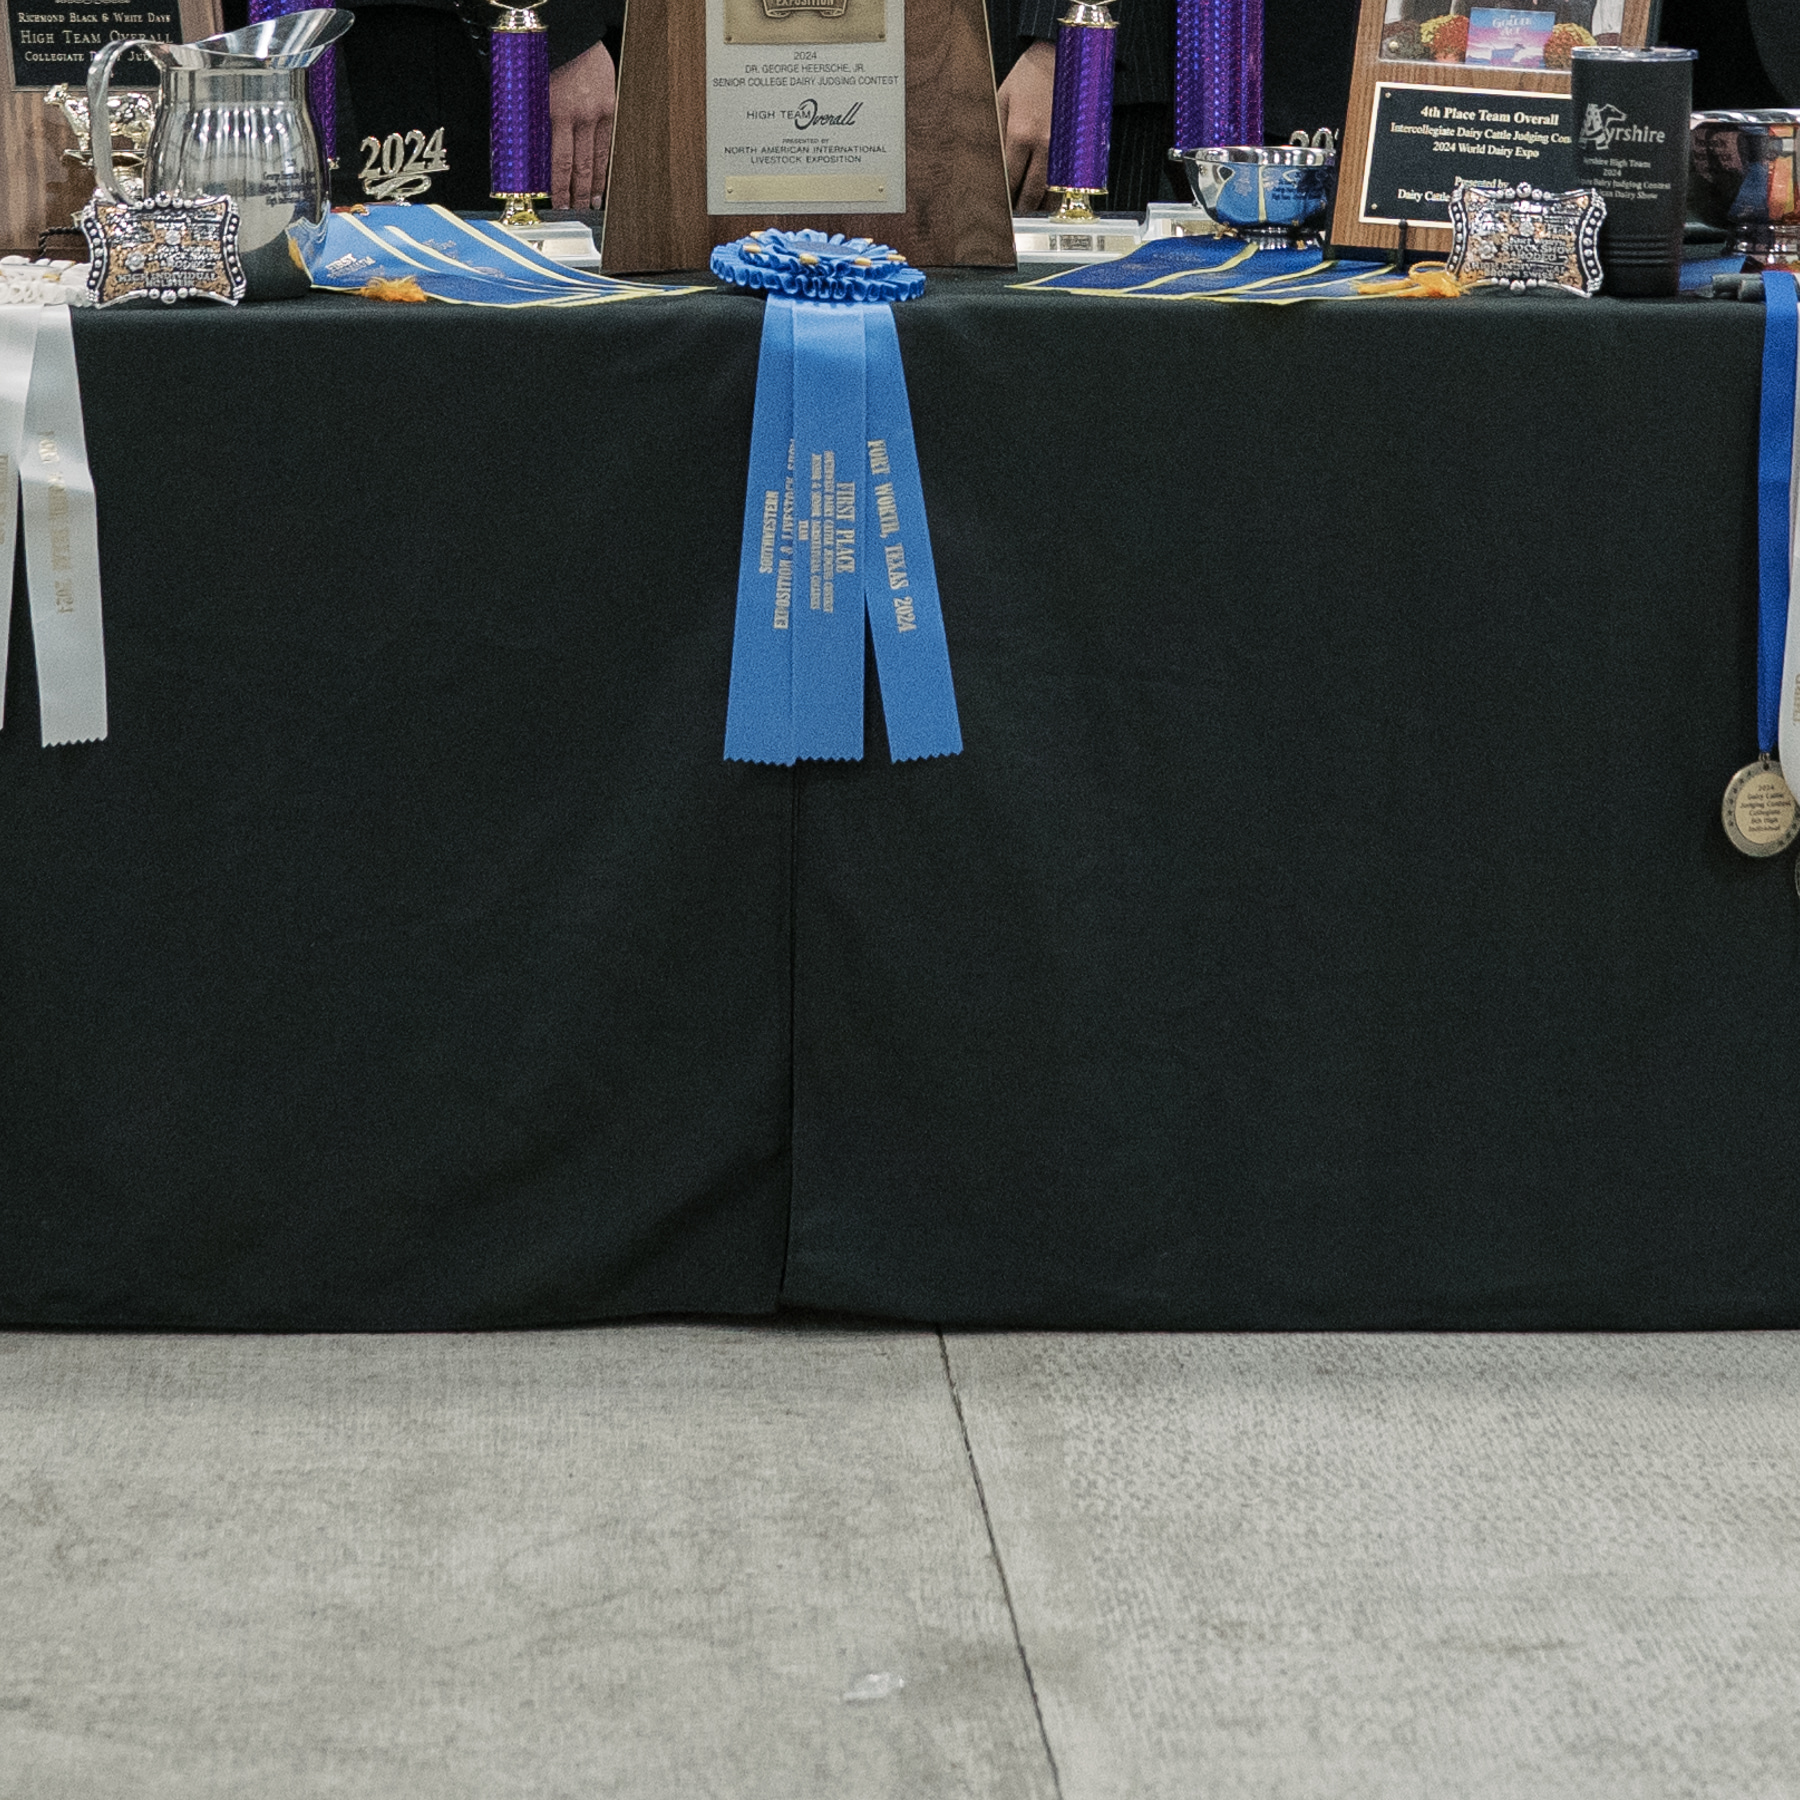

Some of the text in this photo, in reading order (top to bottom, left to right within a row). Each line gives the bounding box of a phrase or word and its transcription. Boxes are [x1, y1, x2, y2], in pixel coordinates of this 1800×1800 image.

[793, 52, 817, 60] 2024
[762, 65, 799, 74] GEORGE
[712, 78, 746, 87] SENIOR
[748, 78, 789, 87] COLLEGE
[789, 77, 816, 86] DAIRY
[857, 75, 899, 84] CONTEST
[746, 98, 864, 130] HIGH TEAM Overall
[1420, 106, 1559, 125] 4th Place Team Overall
[1390, 122, 1455, 139] Intercollegiate
[1457, 126, 1482, 140] Dairy
[1484, 127, 1511, 140] Cattle
[1513, 130, 1549, 144] Judging
[358, 126, 450, 179] 2024
[724, 145, 887, 154] NORTH AMERICAN INTERNATIONAL
[1433, 141, 1540, 160] 2024 World Dairy Expo
[750, 155, 862, 164] LIVESTOCK EXPOSITION
[1397, 189, 1423, 202] Dairy
[835, 482, 855, 573] FIRST PLACE
[884, 543, 909, 589] TEXAS
[893, 595, 917, 633] 2024
